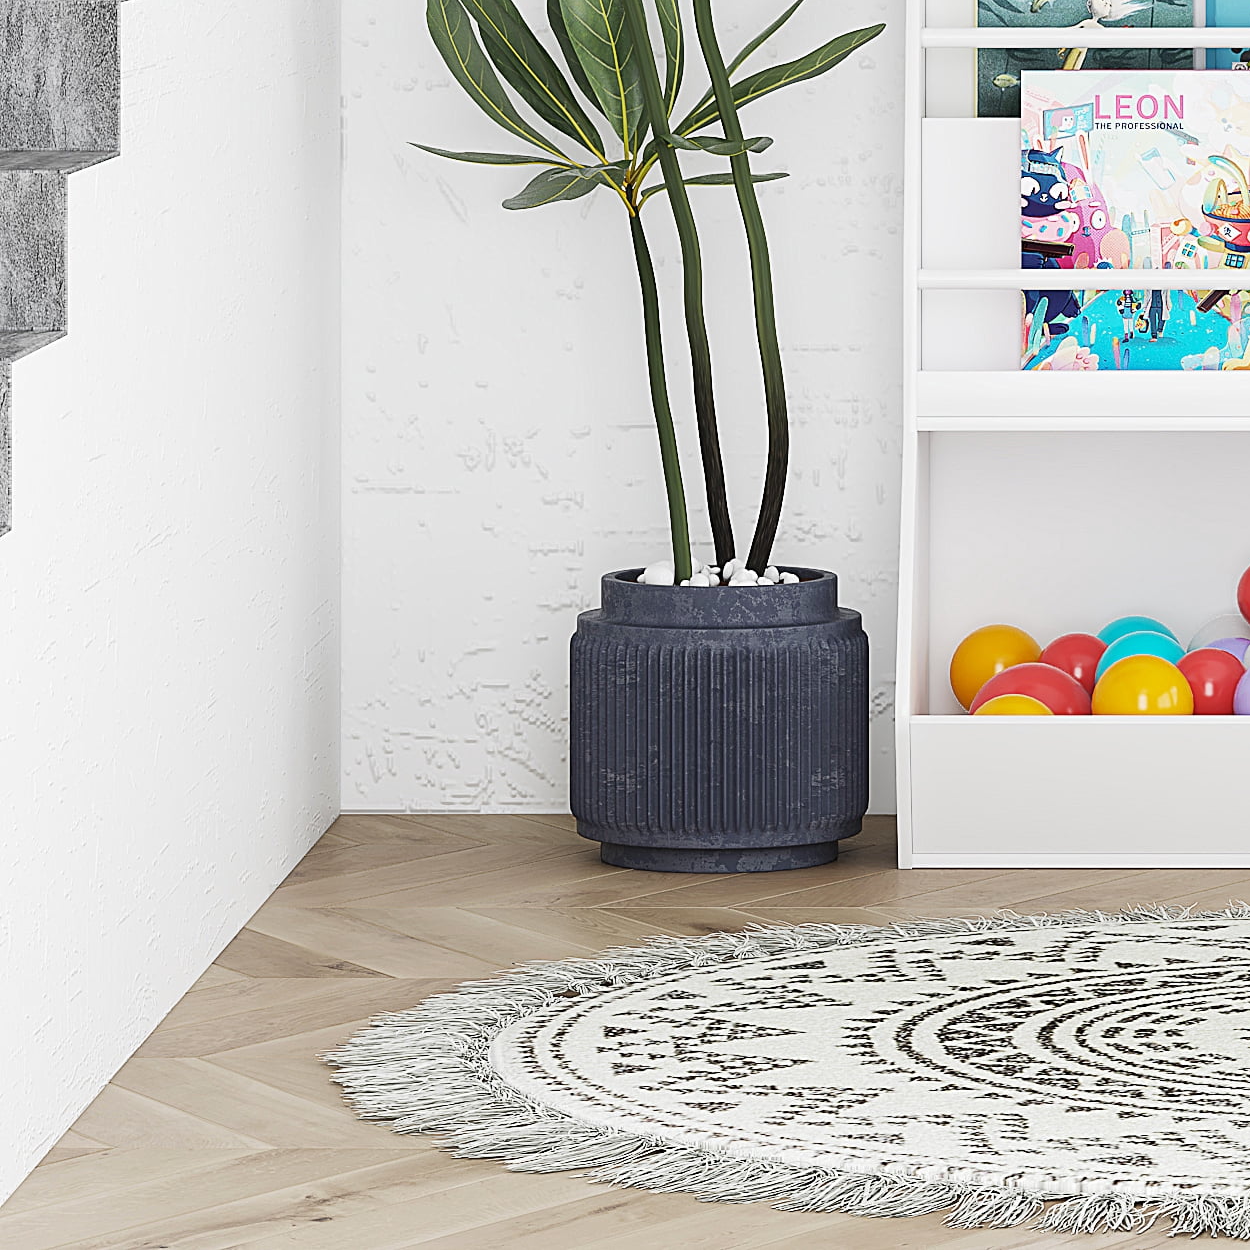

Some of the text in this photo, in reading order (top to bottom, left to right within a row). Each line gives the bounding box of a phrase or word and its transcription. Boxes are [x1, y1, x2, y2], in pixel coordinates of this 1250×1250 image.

[1095, 95, 1184, 119] LEON
[1095, 122, 1184, 130] THE PROFESSIONAL
